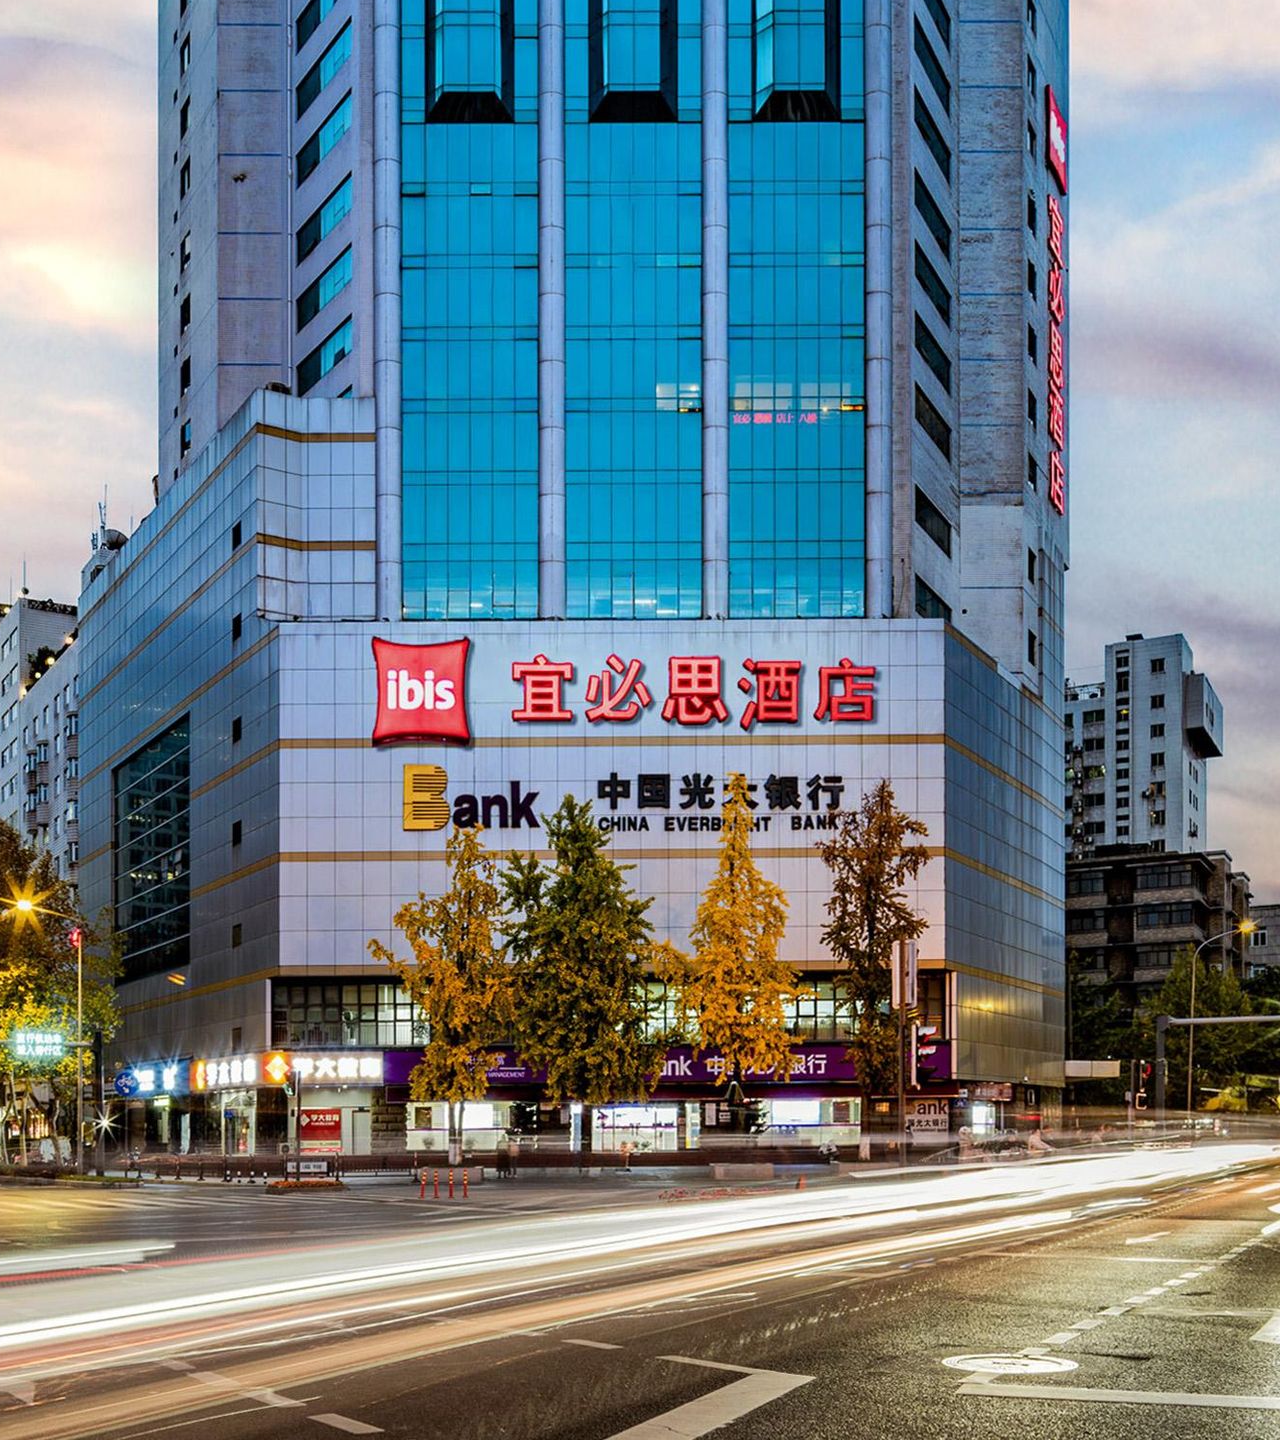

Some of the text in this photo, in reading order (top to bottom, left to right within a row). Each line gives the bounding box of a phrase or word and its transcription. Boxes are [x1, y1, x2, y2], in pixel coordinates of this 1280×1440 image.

[387, 669, 456, 710] ibis
[511, 653, 876, 731] 宜必思酒店
[403, 764, 541, 831] Bank
[598, 816, 649, 832] CHINA
[791, 816, 839, 831] BANK
